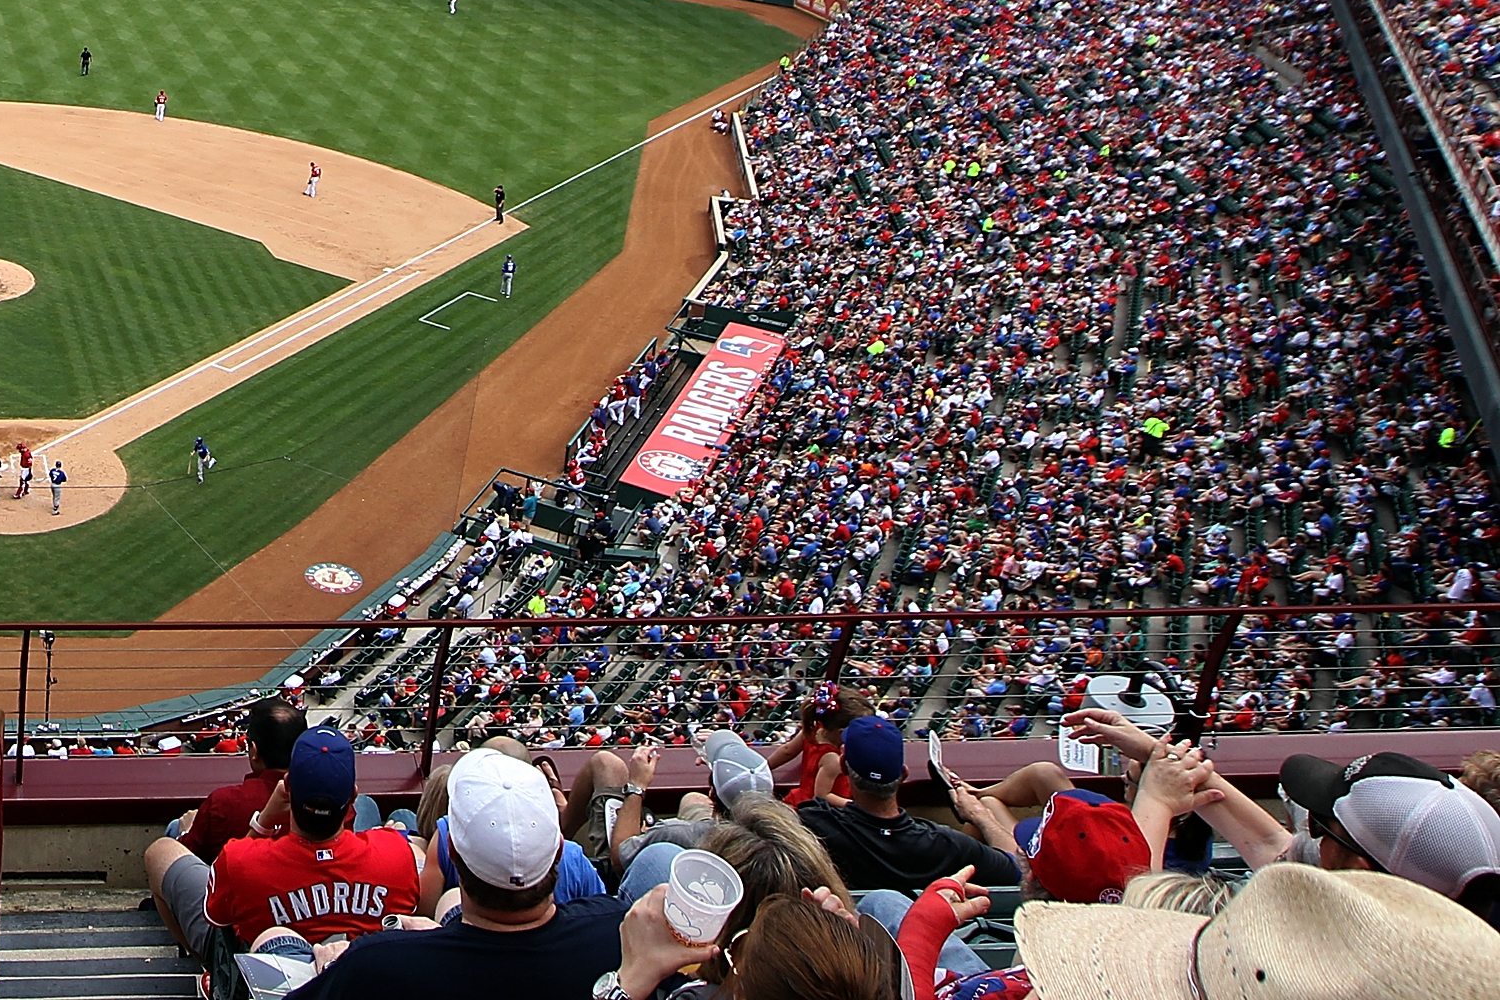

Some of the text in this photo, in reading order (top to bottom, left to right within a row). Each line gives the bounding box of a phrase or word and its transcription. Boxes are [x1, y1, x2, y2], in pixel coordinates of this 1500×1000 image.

[759, 317, 788, 328] SOUTHWEST
[660, 361, 759, 446] RANGERS
[268, 881, 389, 927] ANDRUS
